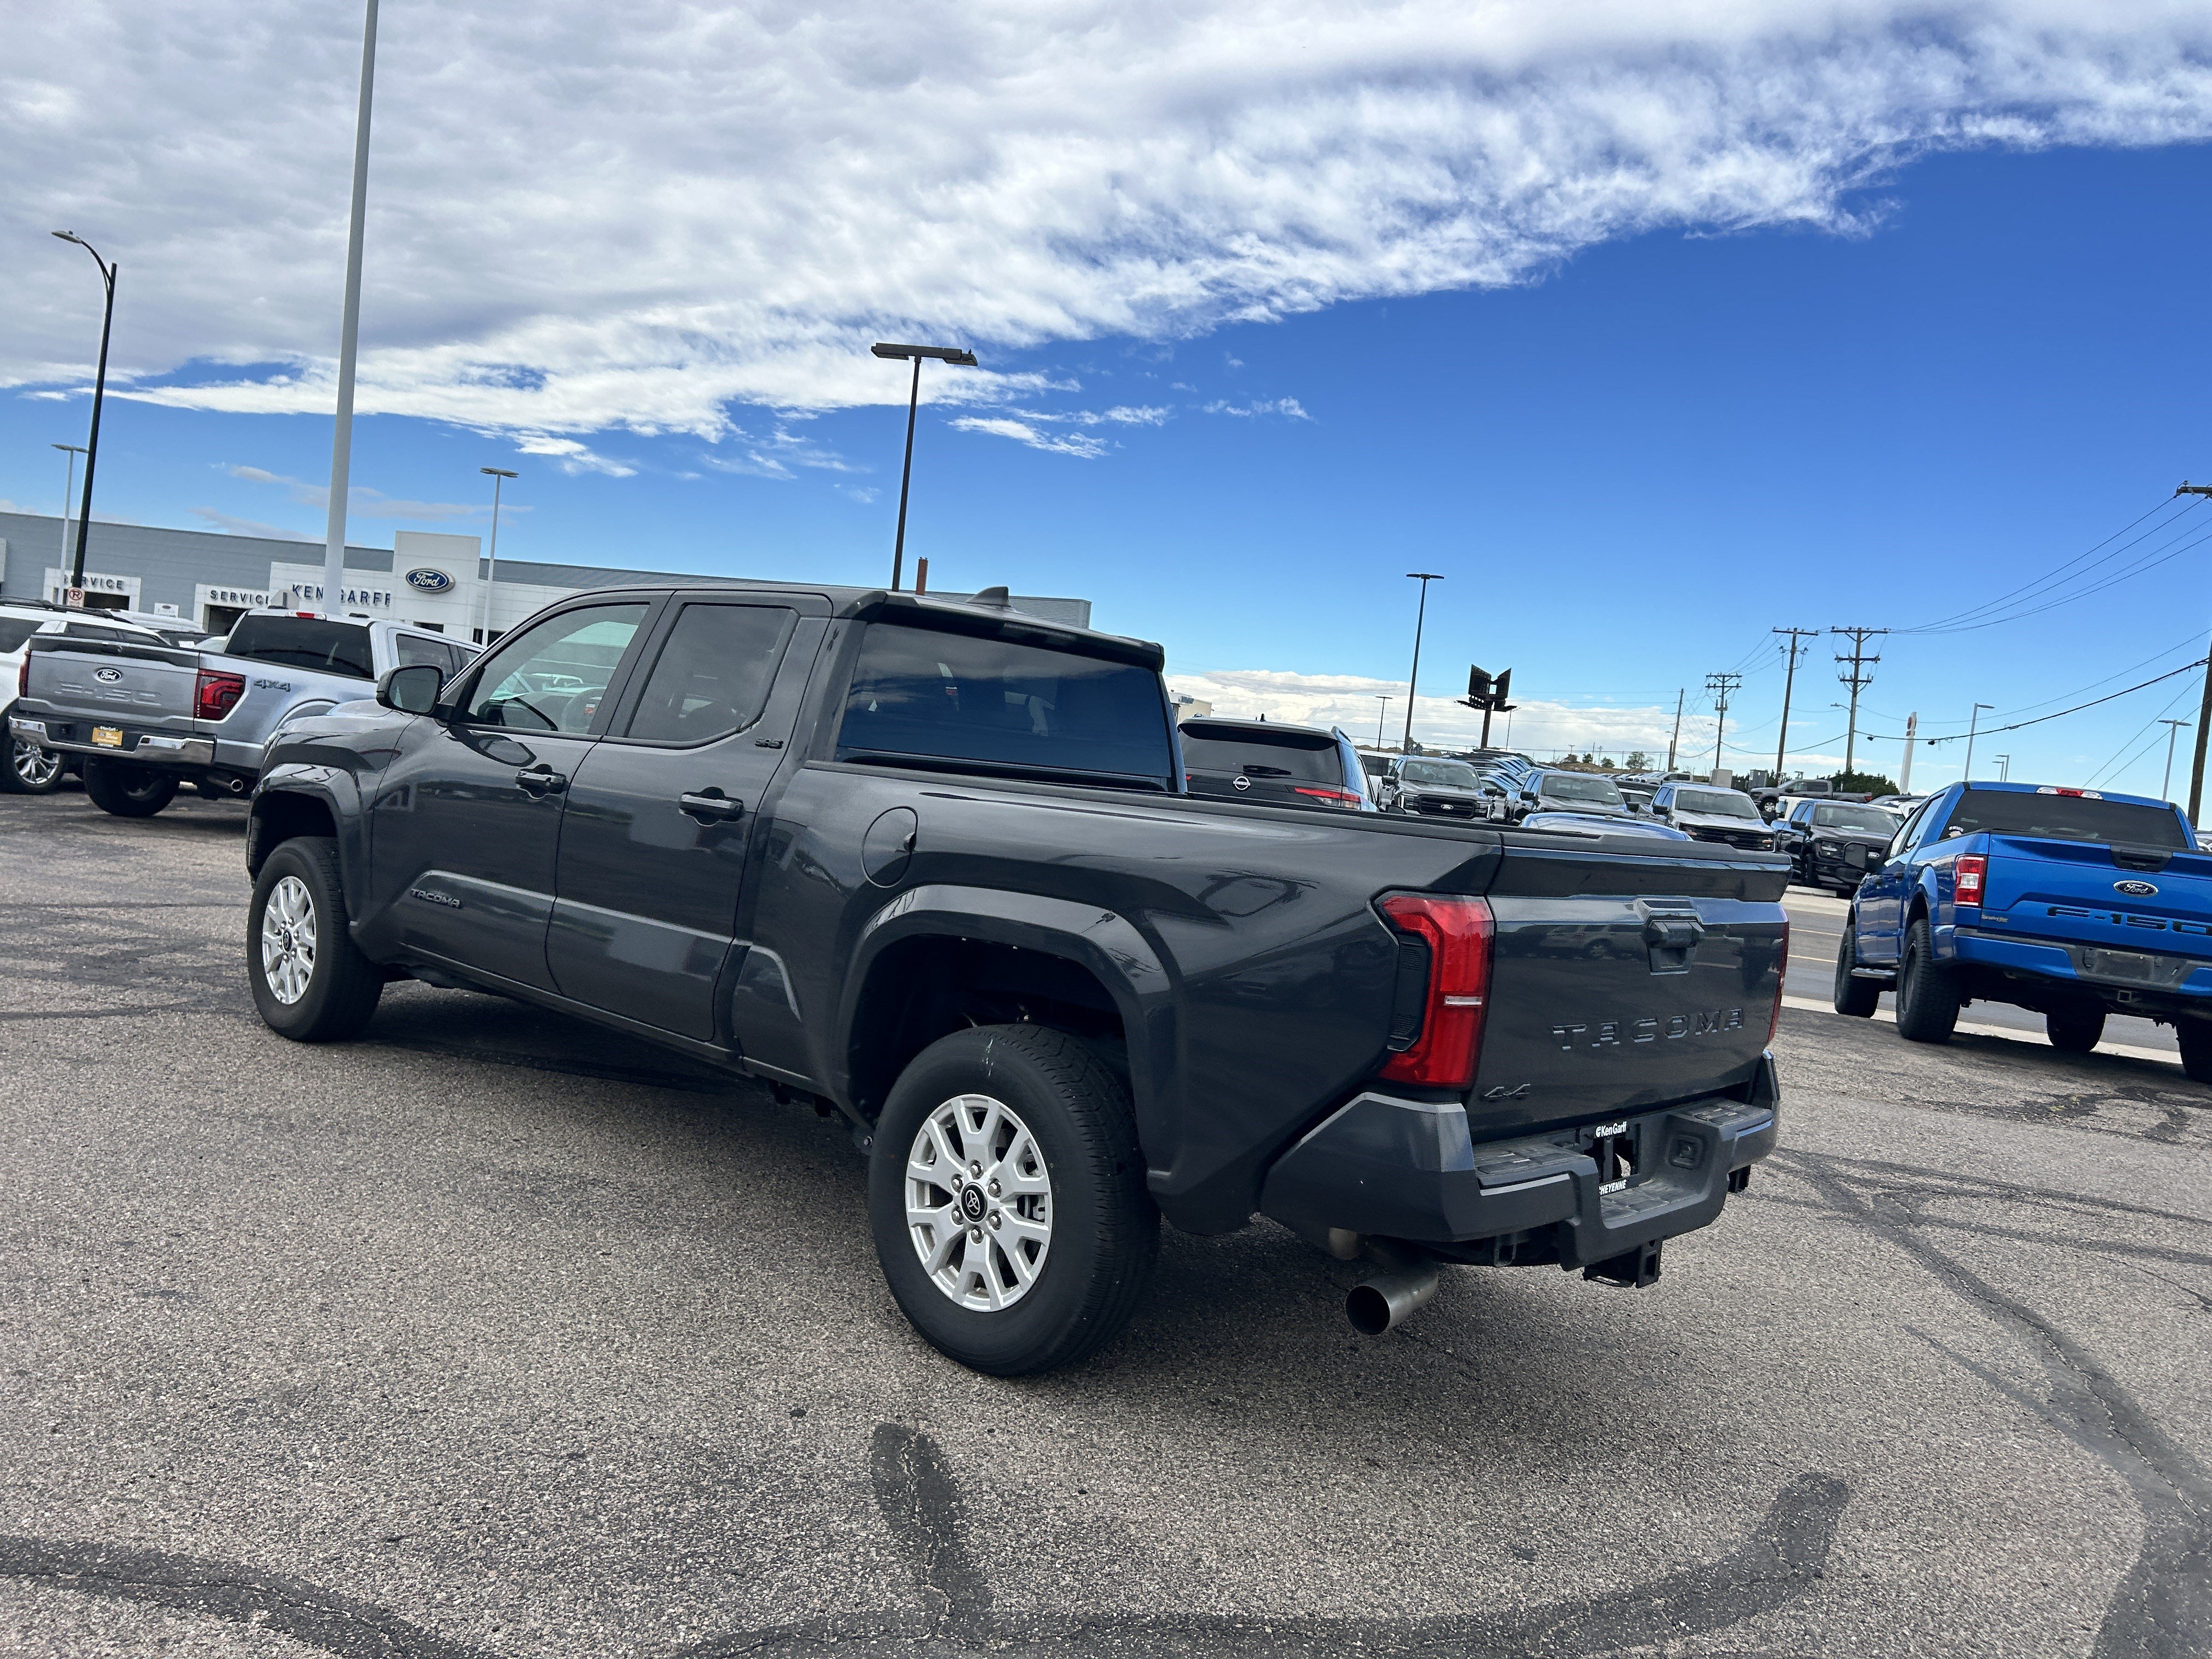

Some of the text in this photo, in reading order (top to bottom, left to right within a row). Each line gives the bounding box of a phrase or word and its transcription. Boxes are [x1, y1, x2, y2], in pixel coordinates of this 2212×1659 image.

[64, 574, 123, 589] RVICE
[414, 571, 440, 586] Ford
[292, 584, 323, 599] KEN
[100, 670, 117, 680] Ford
[755, 737, 784, 749] SR5
[2124, 883, 2149, 895] Ford
[411, 888, 461, 909] TACOMA
[1552, 1007, 1744, 1051] TACOMA
